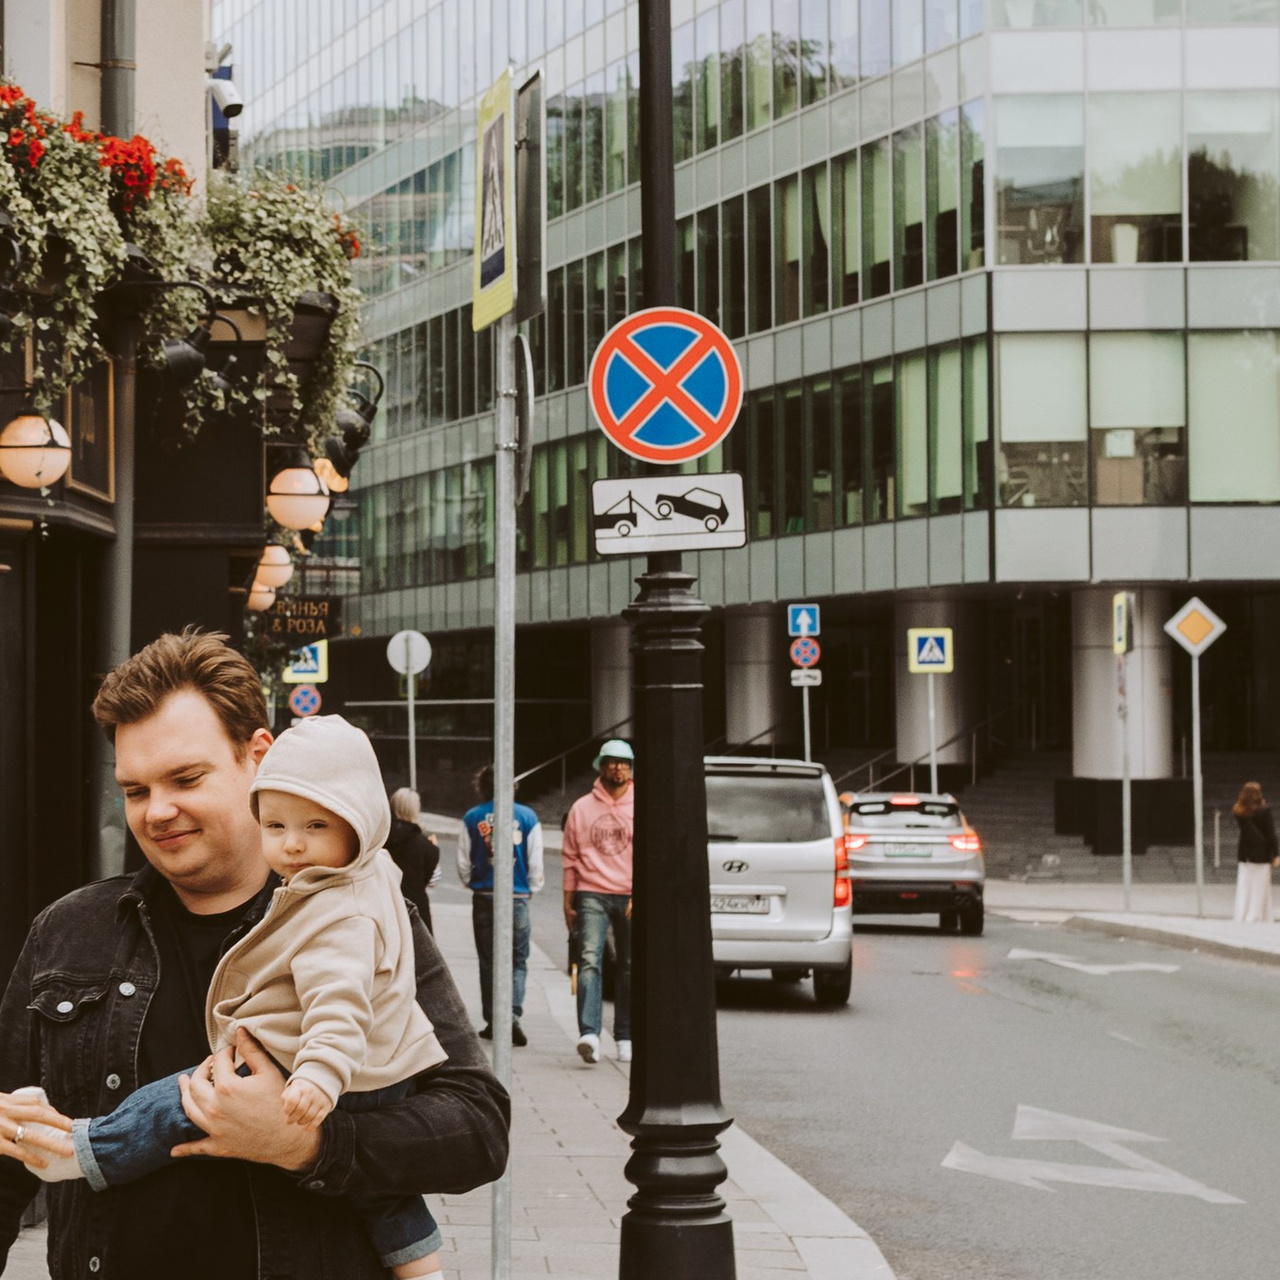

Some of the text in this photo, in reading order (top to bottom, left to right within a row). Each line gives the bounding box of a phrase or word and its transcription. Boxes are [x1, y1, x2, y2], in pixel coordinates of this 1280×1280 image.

[268, 600, 329, 618] ВИНЬЯ
[272, 618, 326, 634] & РОЗА
